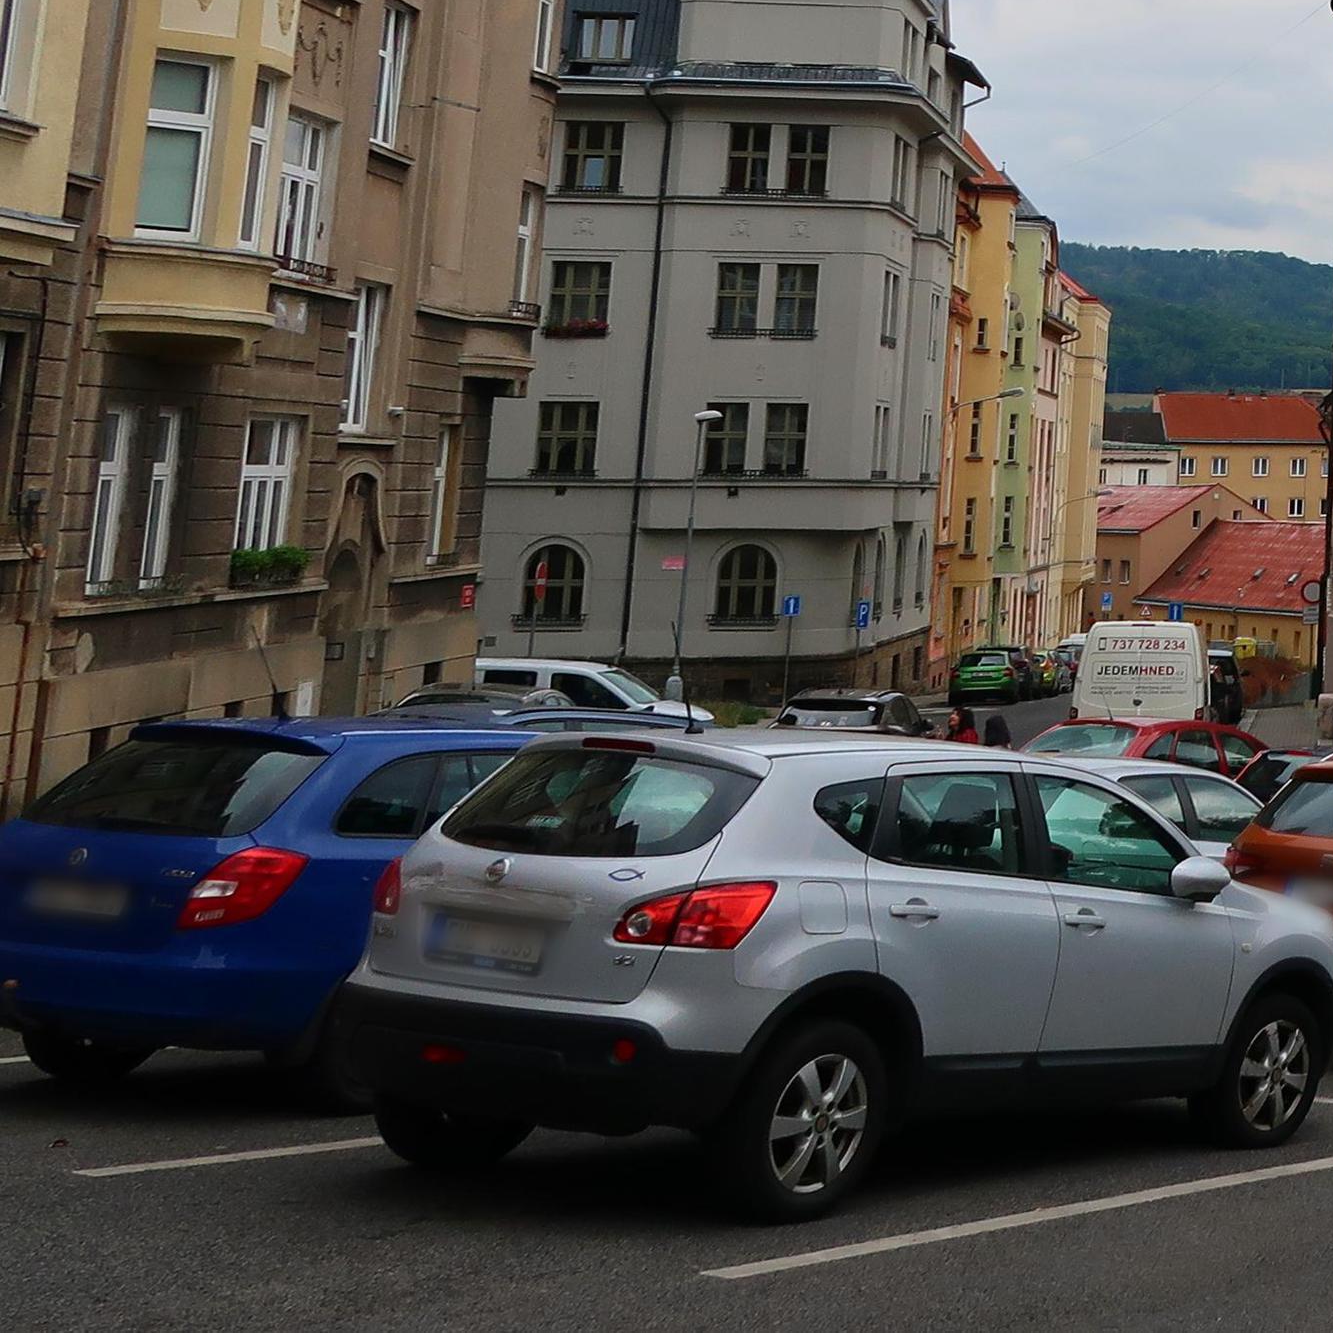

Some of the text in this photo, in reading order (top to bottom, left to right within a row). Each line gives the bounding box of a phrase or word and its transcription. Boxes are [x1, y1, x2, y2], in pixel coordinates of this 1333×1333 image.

[859, 604, 868, 620] P
[1112, 639, 1186, 651] 737 728 234
